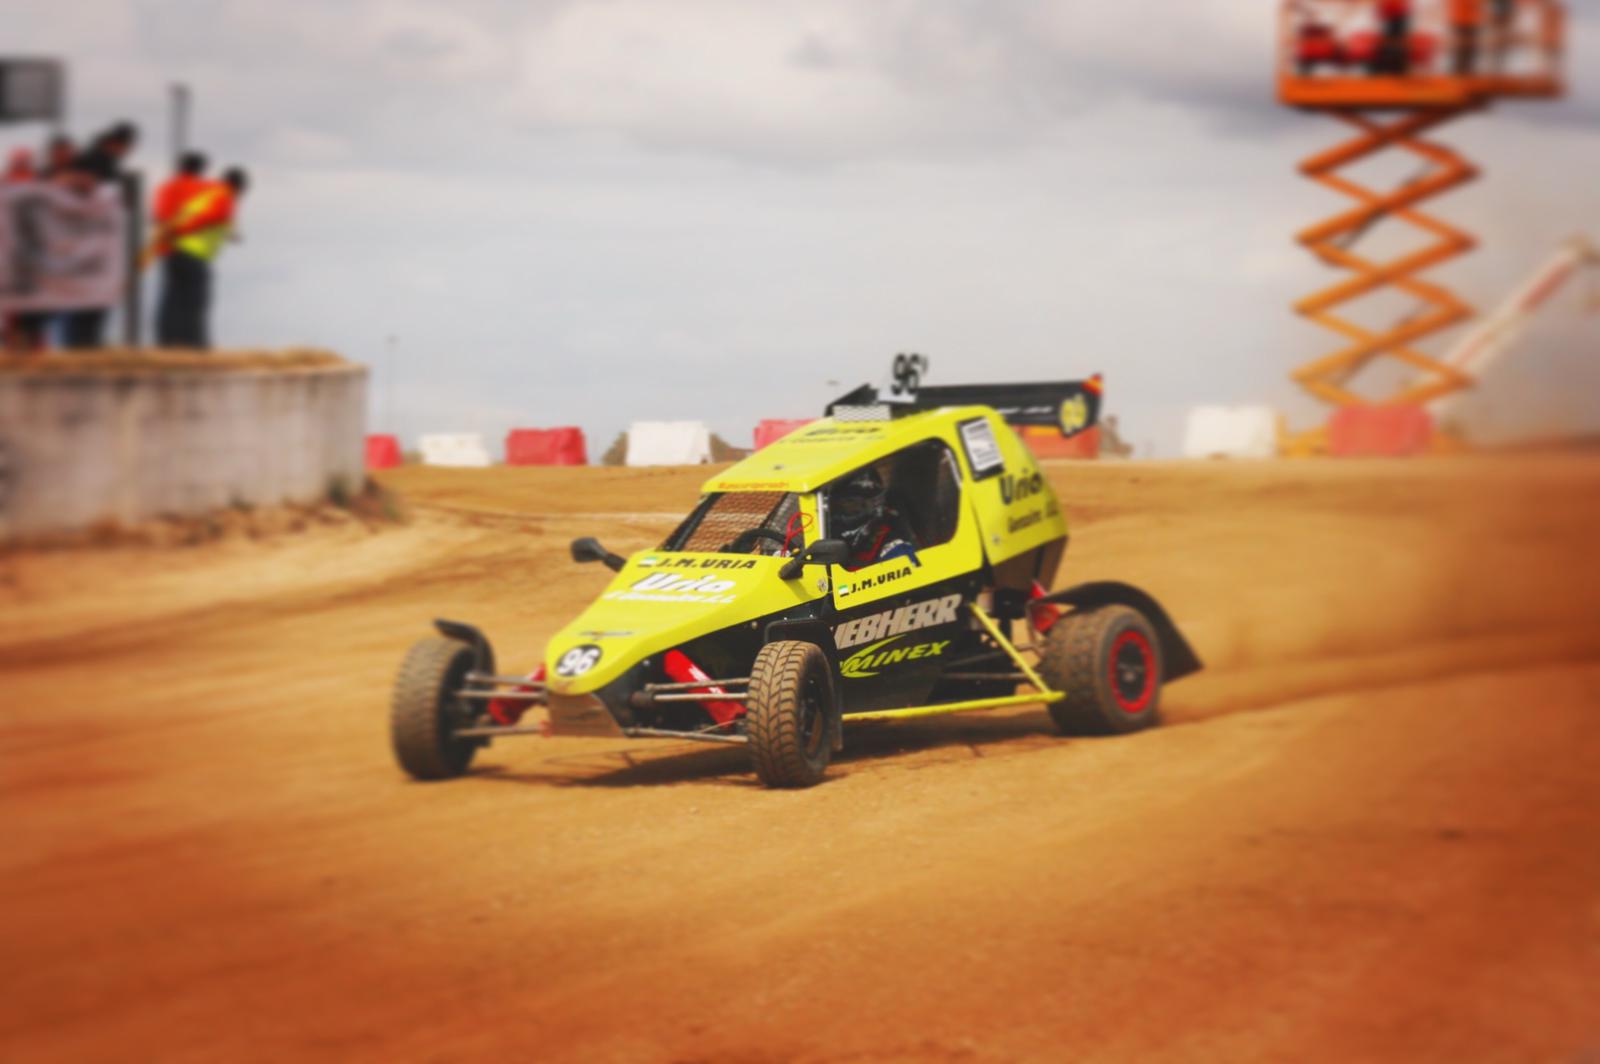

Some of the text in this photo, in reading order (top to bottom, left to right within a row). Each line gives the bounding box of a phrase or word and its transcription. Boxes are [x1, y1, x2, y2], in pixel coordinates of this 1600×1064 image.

[892, 353, 920, 395] 96
[656, 558, 757, 570] J.M.URIA
[850, 566, 912, 594] J.M.URIA
[557, 648, 600, 676] 96
